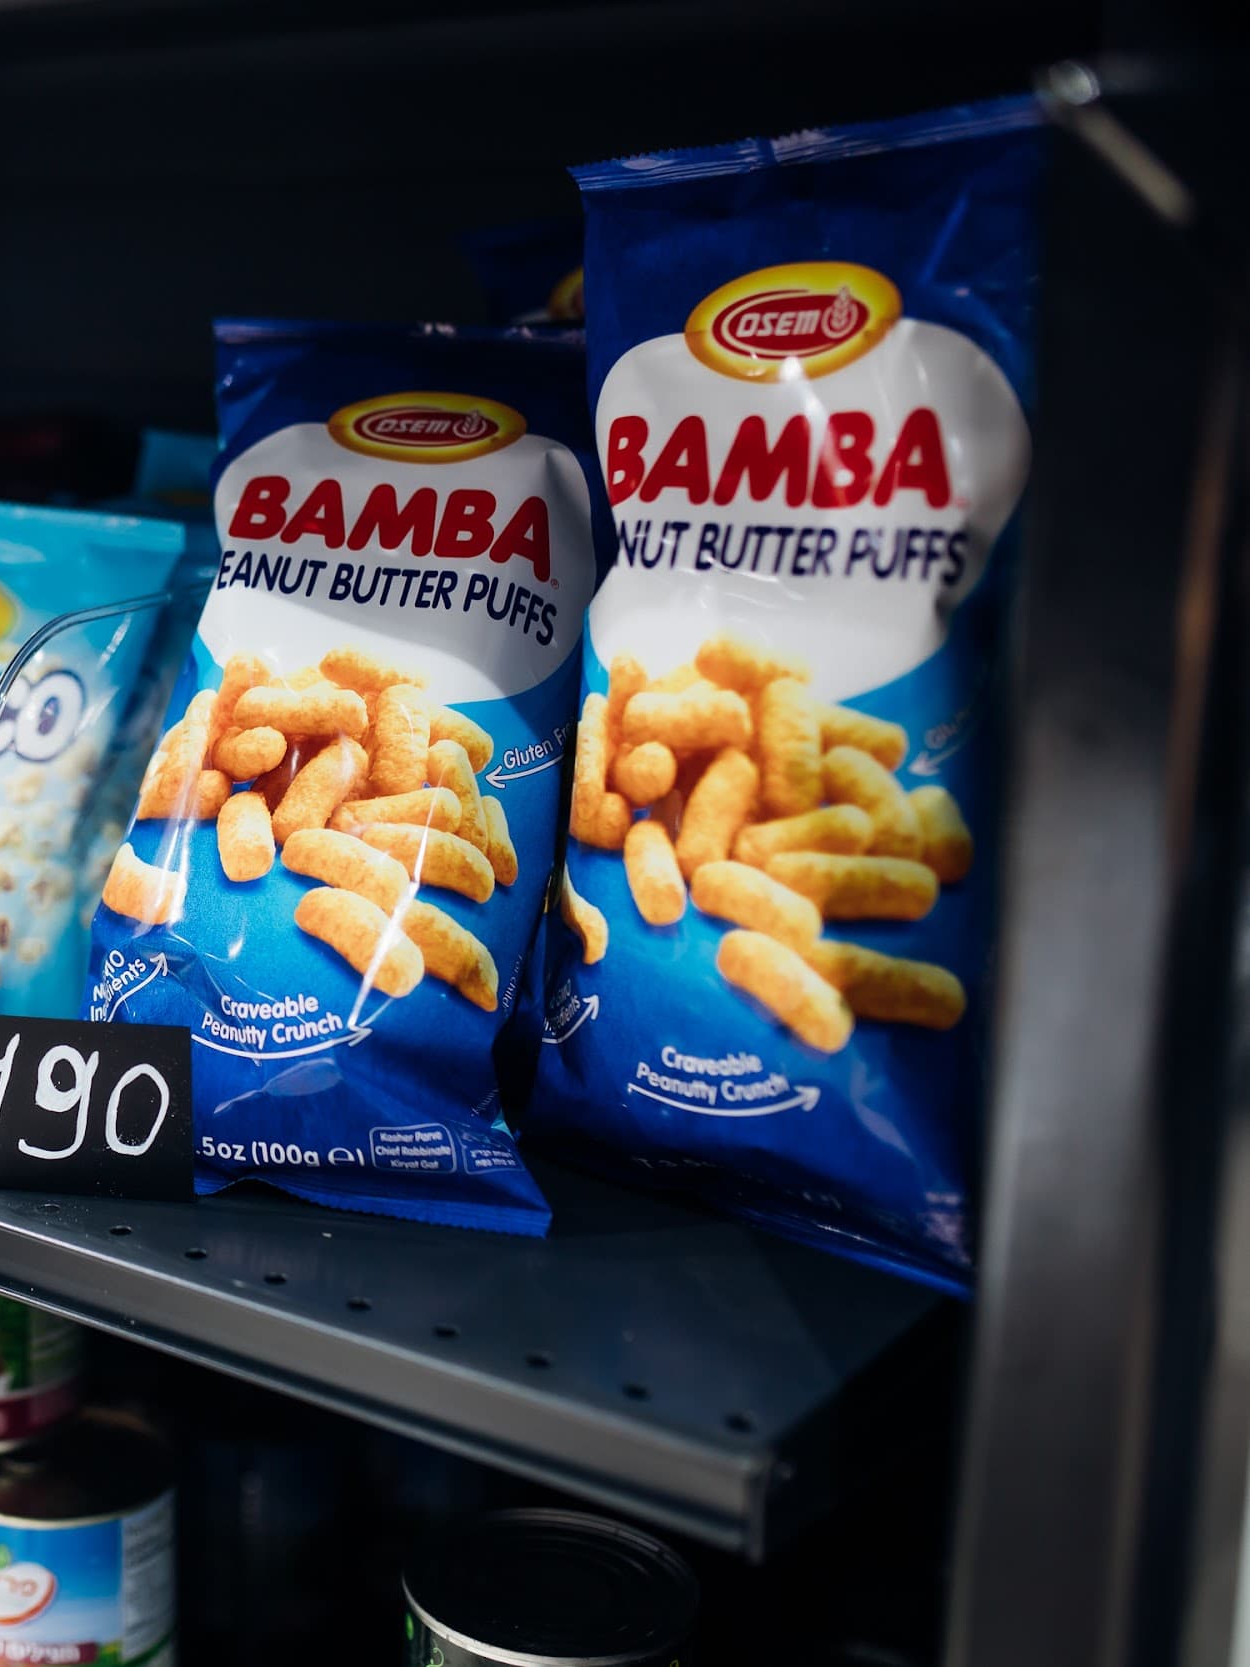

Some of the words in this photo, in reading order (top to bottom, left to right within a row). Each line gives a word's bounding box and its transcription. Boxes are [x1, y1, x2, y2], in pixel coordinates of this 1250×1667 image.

[736, 309, 819, 338] OSEM
[374, 418, 451, 436] OSEM
[607, 407, 952, 509] BAMBA
[228, 476, 551, 584] BAMBA
[616, 520, 692, 570] NUT
[694, 523, 838, 577] BUTTER
[846, 527, 969, 586] PUFFS
[216, 550, 327, 597] EANUT
[329, 562, 458, 610] BUTTER
[463, 574, 558, 646] PUFFS
[503, 739, 554, 769] Gluten
[221, 993, 319, 1020] Craveable
[201, 1011, 268, 1050] Peanutty
[272, 1011, 343, 1044] Crunch
[661, 1045, 764, 1076] Craveable
[636, 1061, 718, 1106] Peanutty
[721, 1072, 791, 1101] Crunch
[196, 1136, 247, 1162] .5oz
[375, 1145, 400, 1157] Chief
[380, 1131, 414, 1143] Kosher
